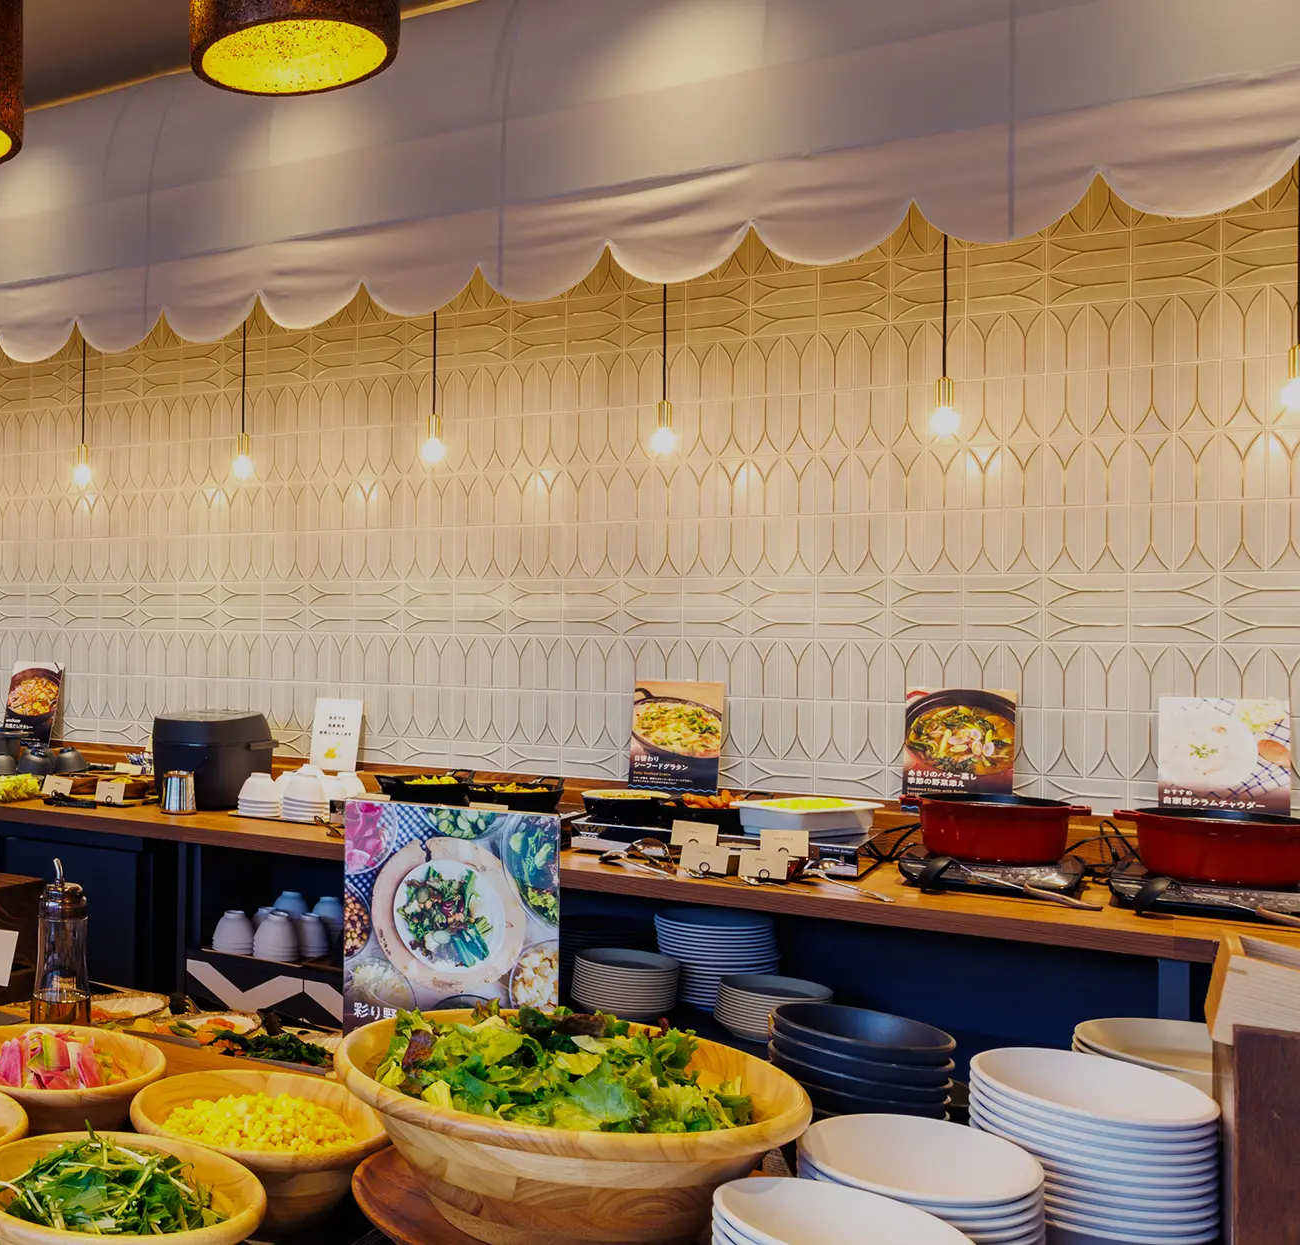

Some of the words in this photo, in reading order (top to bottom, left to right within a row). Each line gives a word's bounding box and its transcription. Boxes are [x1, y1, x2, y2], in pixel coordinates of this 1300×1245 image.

[634, 754, 659, 762] 日替わり
[633, 762, 689, 771] シーフードグラタン
[907, 769, 977, 780] あさりのバター蒸し
[907, 777, 965, 787] 季節の野菜添え
[1163, 788, 1193, 796] おすすめ
[1162, 796, 1266, 809] 自家製クラムチャウダー
